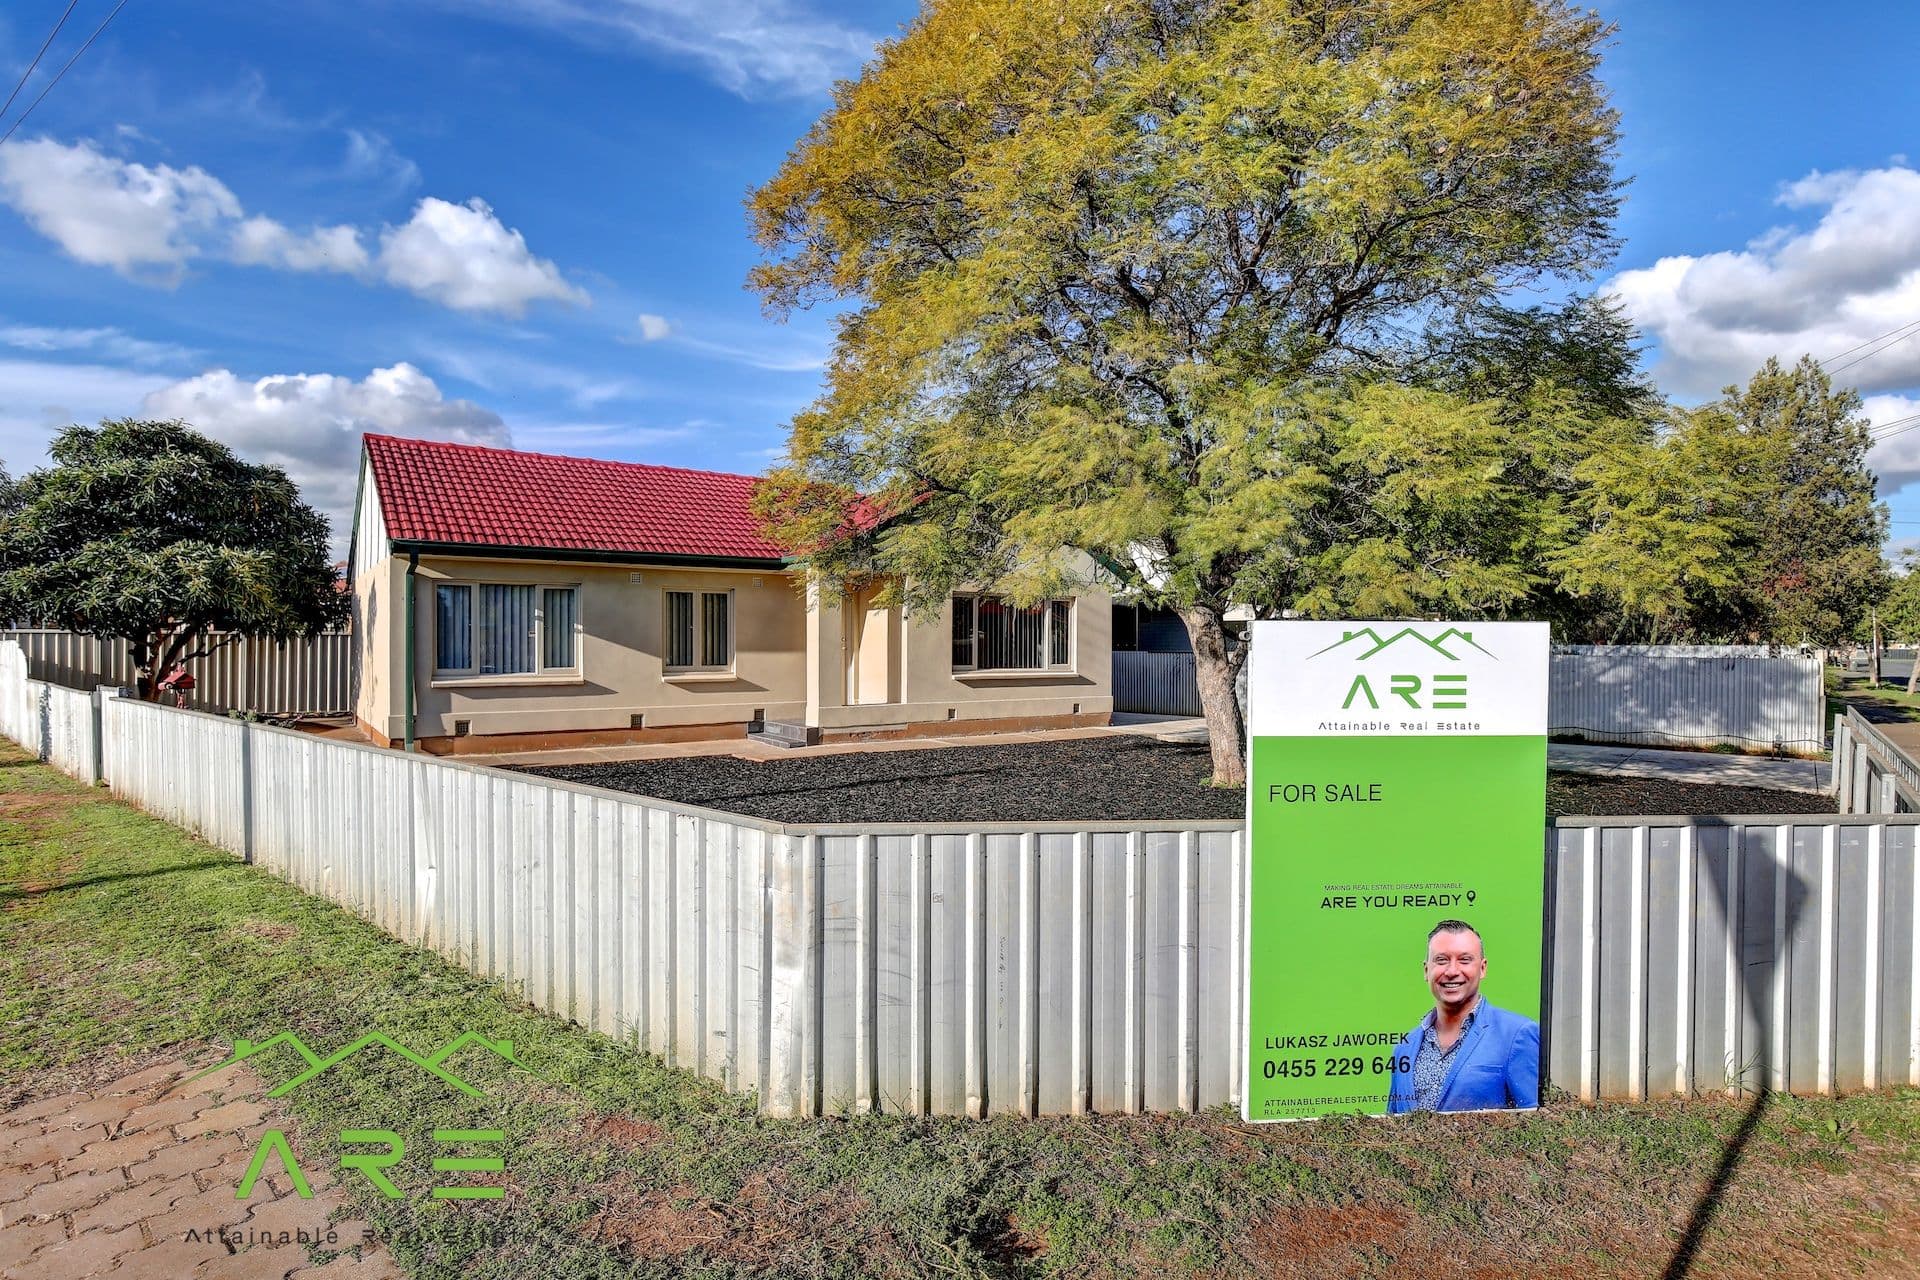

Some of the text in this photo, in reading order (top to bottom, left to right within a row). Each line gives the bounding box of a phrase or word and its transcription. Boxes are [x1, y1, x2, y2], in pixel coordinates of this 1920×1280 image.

[1341, 674, 1468, 709] ARE
[1318, 720, 1481, 731] Attainable Real Estate
[1269, 784, 1382, 803] FOR SALE
[1321, 894, 1462, 909] ARE YOU READY
[1265, 1033, 1409, 1049] LUKASZ JAWOREK
[1263, 1055, 1411, 1079] 0455 229 646
[1264, 1094, 1419, 1107] ATTAINABLEREALESTATE.COMAU
[1264, 1108, 1281, 1116] RLA
